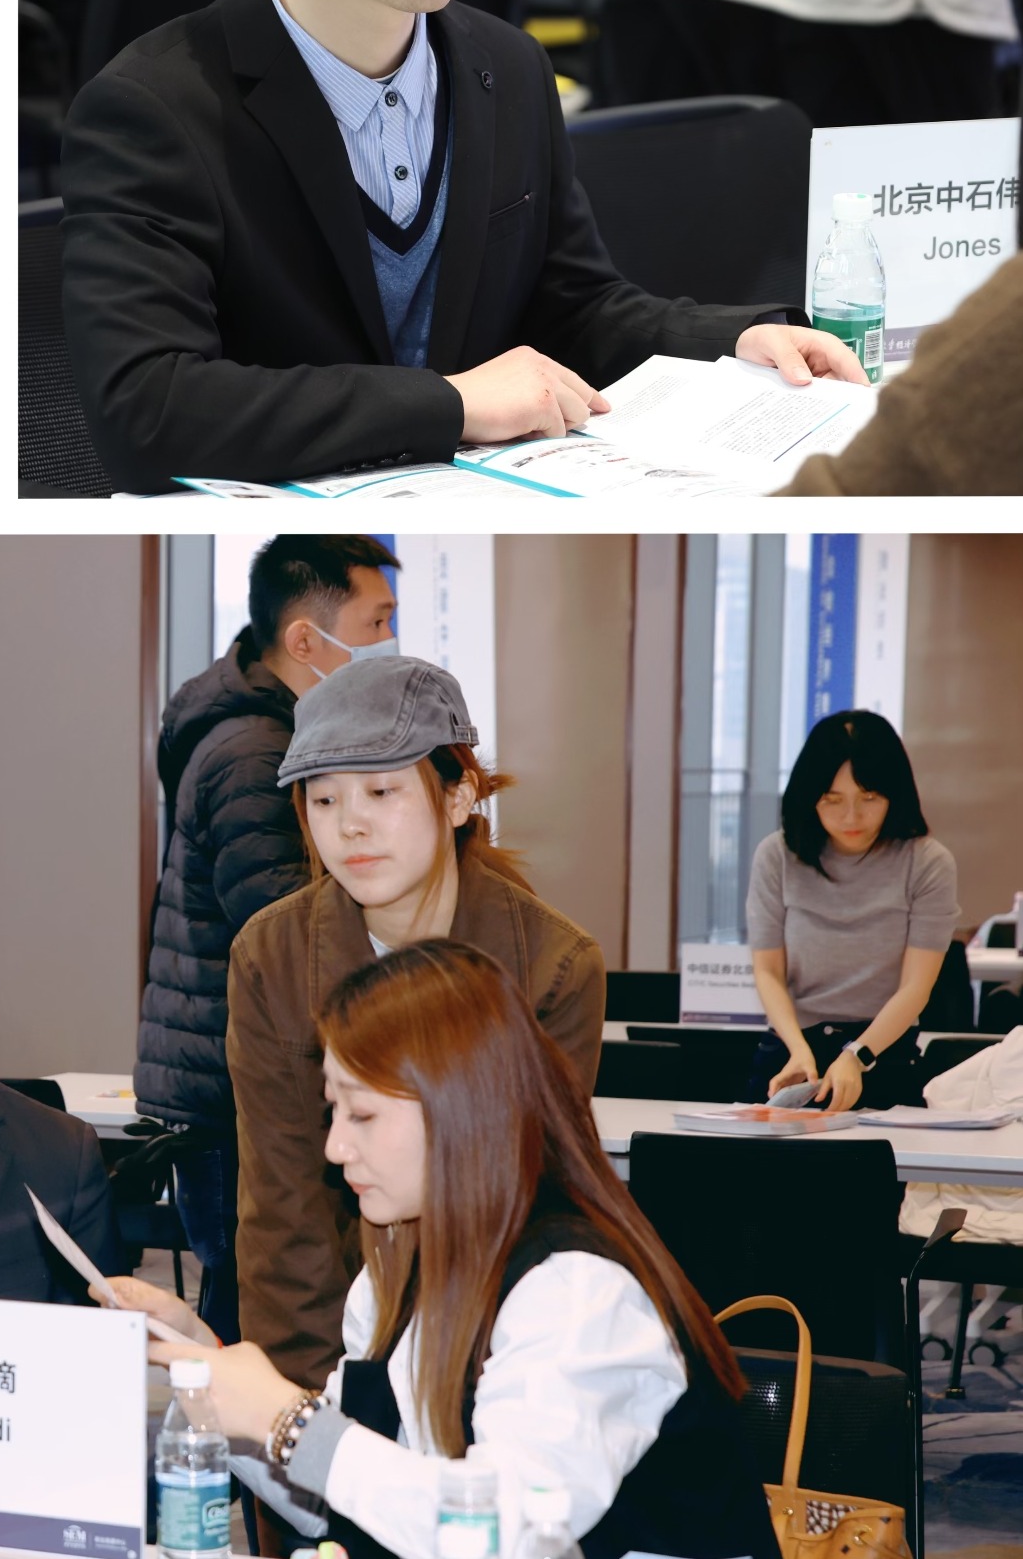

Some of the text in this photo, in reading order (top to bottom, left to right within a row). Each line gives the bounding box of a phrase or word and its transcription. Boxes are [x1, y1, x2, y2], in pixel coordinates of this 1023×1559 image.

[873, 177, 1020, 217] 北京中石伟
[924, 236, 1001, 261] Jones
